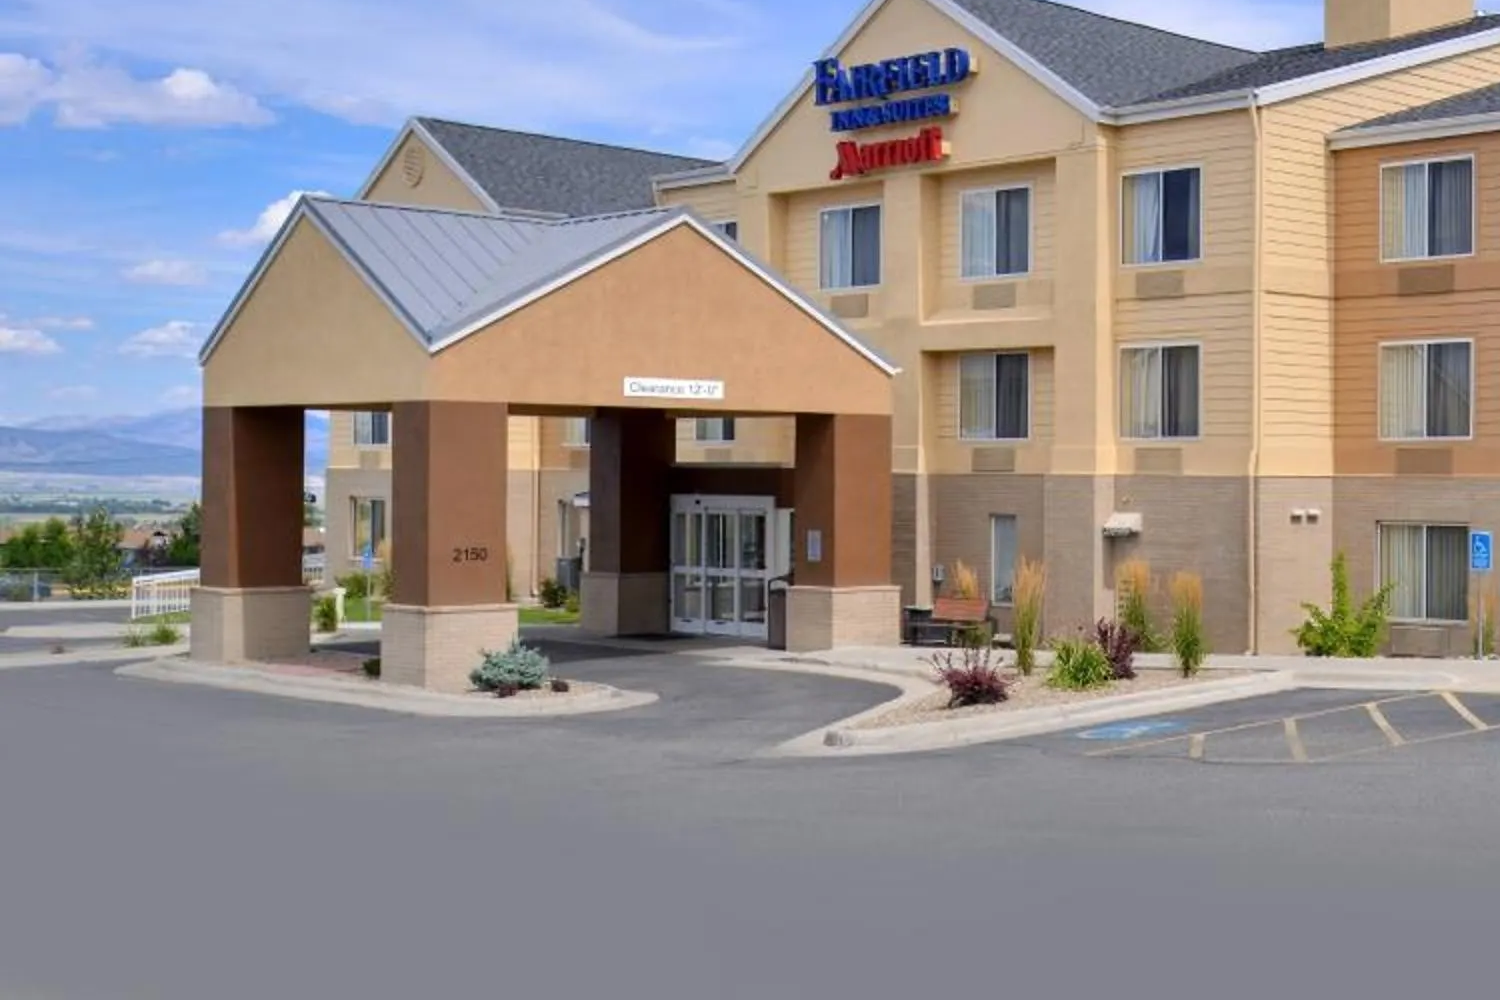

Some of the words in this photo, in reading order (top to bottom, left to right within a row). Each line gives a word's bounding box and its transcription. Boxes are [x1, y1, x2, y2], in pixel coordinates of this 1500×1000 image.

[814, 47, 969, 105] FAIRFIELD
[882, 94, 950, 123] SUITES
[830, 126, 942, 180] Marriott
[452, 547, 488, 562] 2150
